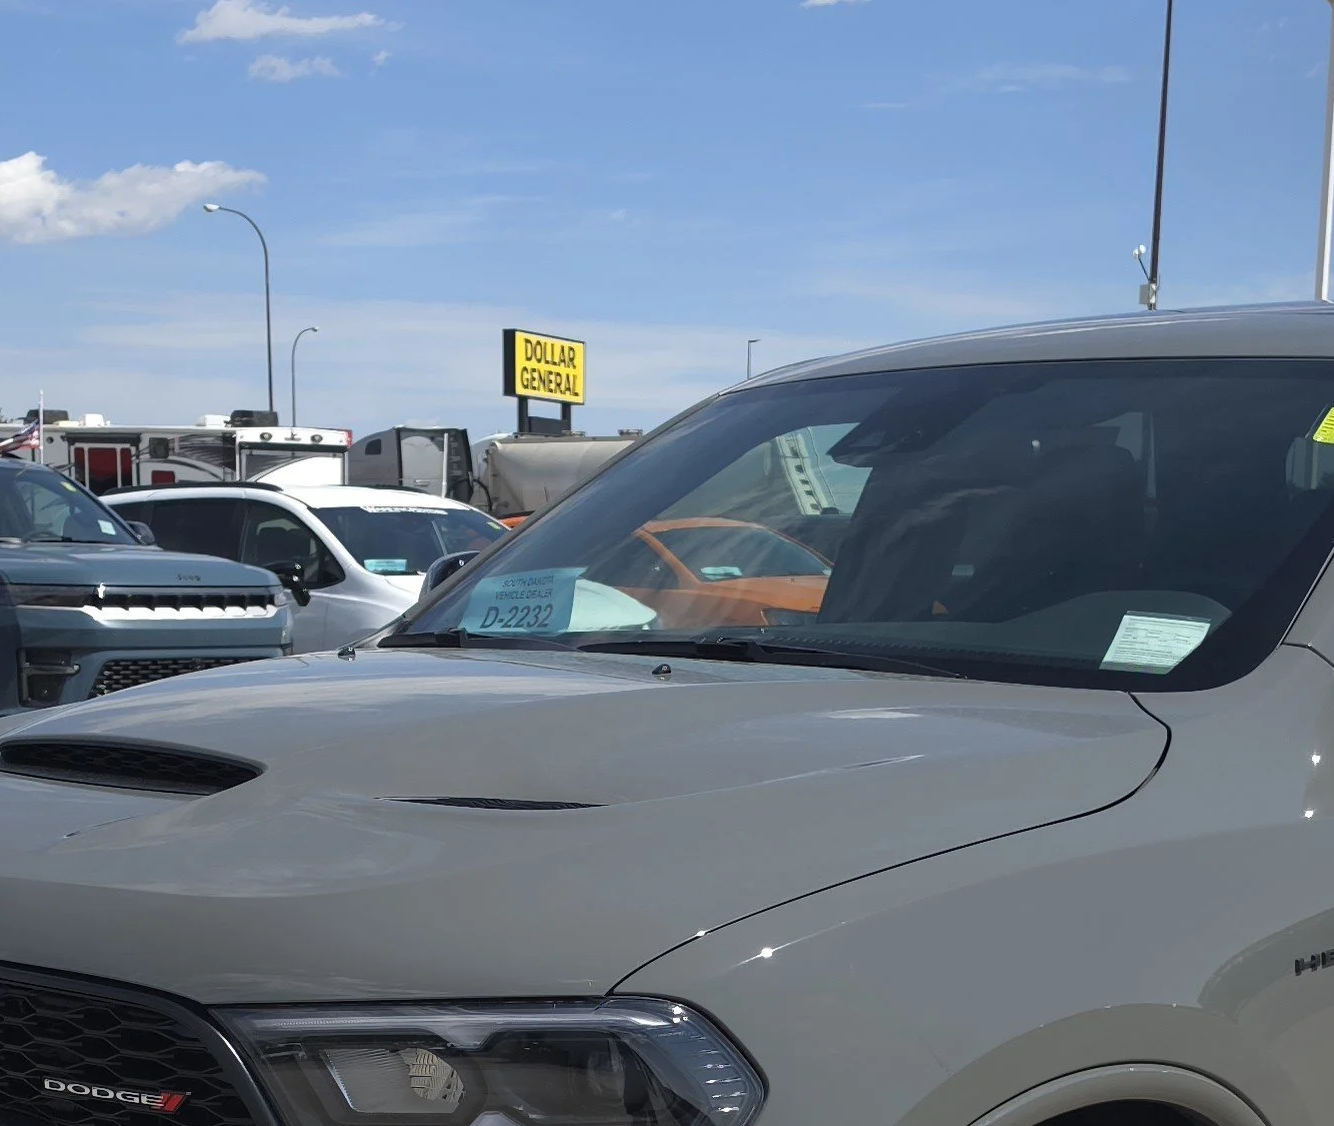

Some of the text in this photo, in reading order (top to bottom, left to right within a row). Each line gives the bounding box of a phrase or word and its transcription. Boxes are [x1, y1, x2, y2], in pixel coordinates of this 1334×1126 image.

[523, 338, 577, 370] DOLLAR
[520, 366, 580, 397] GENERAL
[495, 588, 553, 601] VEHICLE DEALER
[501, 578, 528, 588] SOUTH
[479, 603, 555, 629] D-2232
[44, 1078, 165, 1108] DODGE
